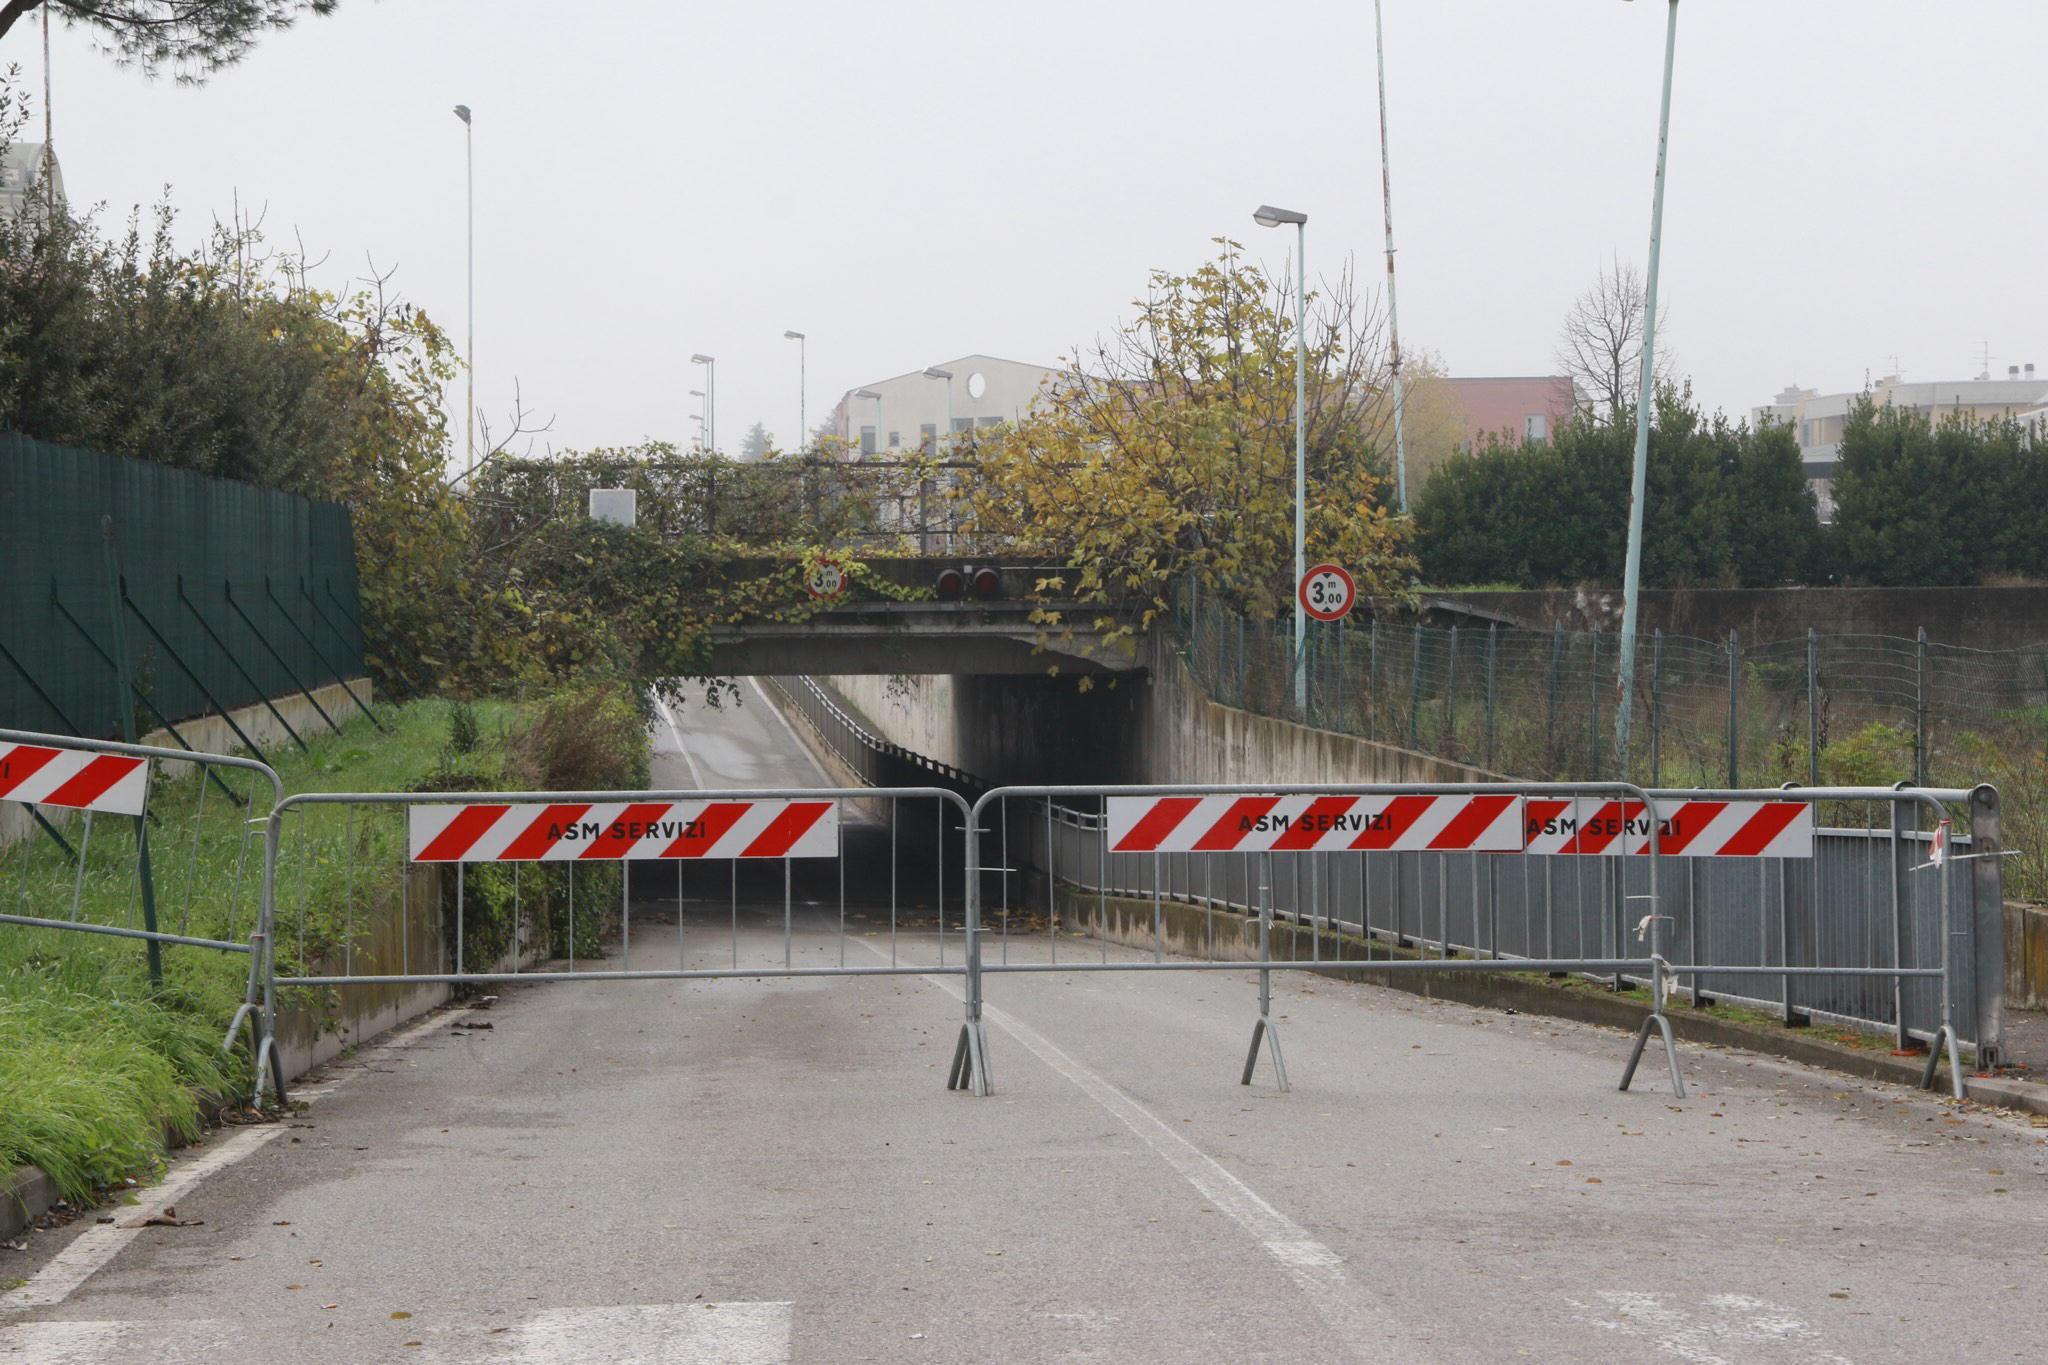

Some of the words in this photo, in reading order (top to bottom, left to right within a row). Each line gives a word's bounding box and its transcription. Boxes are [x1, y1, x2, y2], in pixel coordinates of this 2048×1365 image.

[547, 823, 600, 840] ASM
[612, 821, 706, 839] SERVIZI
[1239, 816, 1289, 832] ASM
[1302, 815, 1391, 831] SERVIZI
[1528, 819, 1577, 835] ASM
